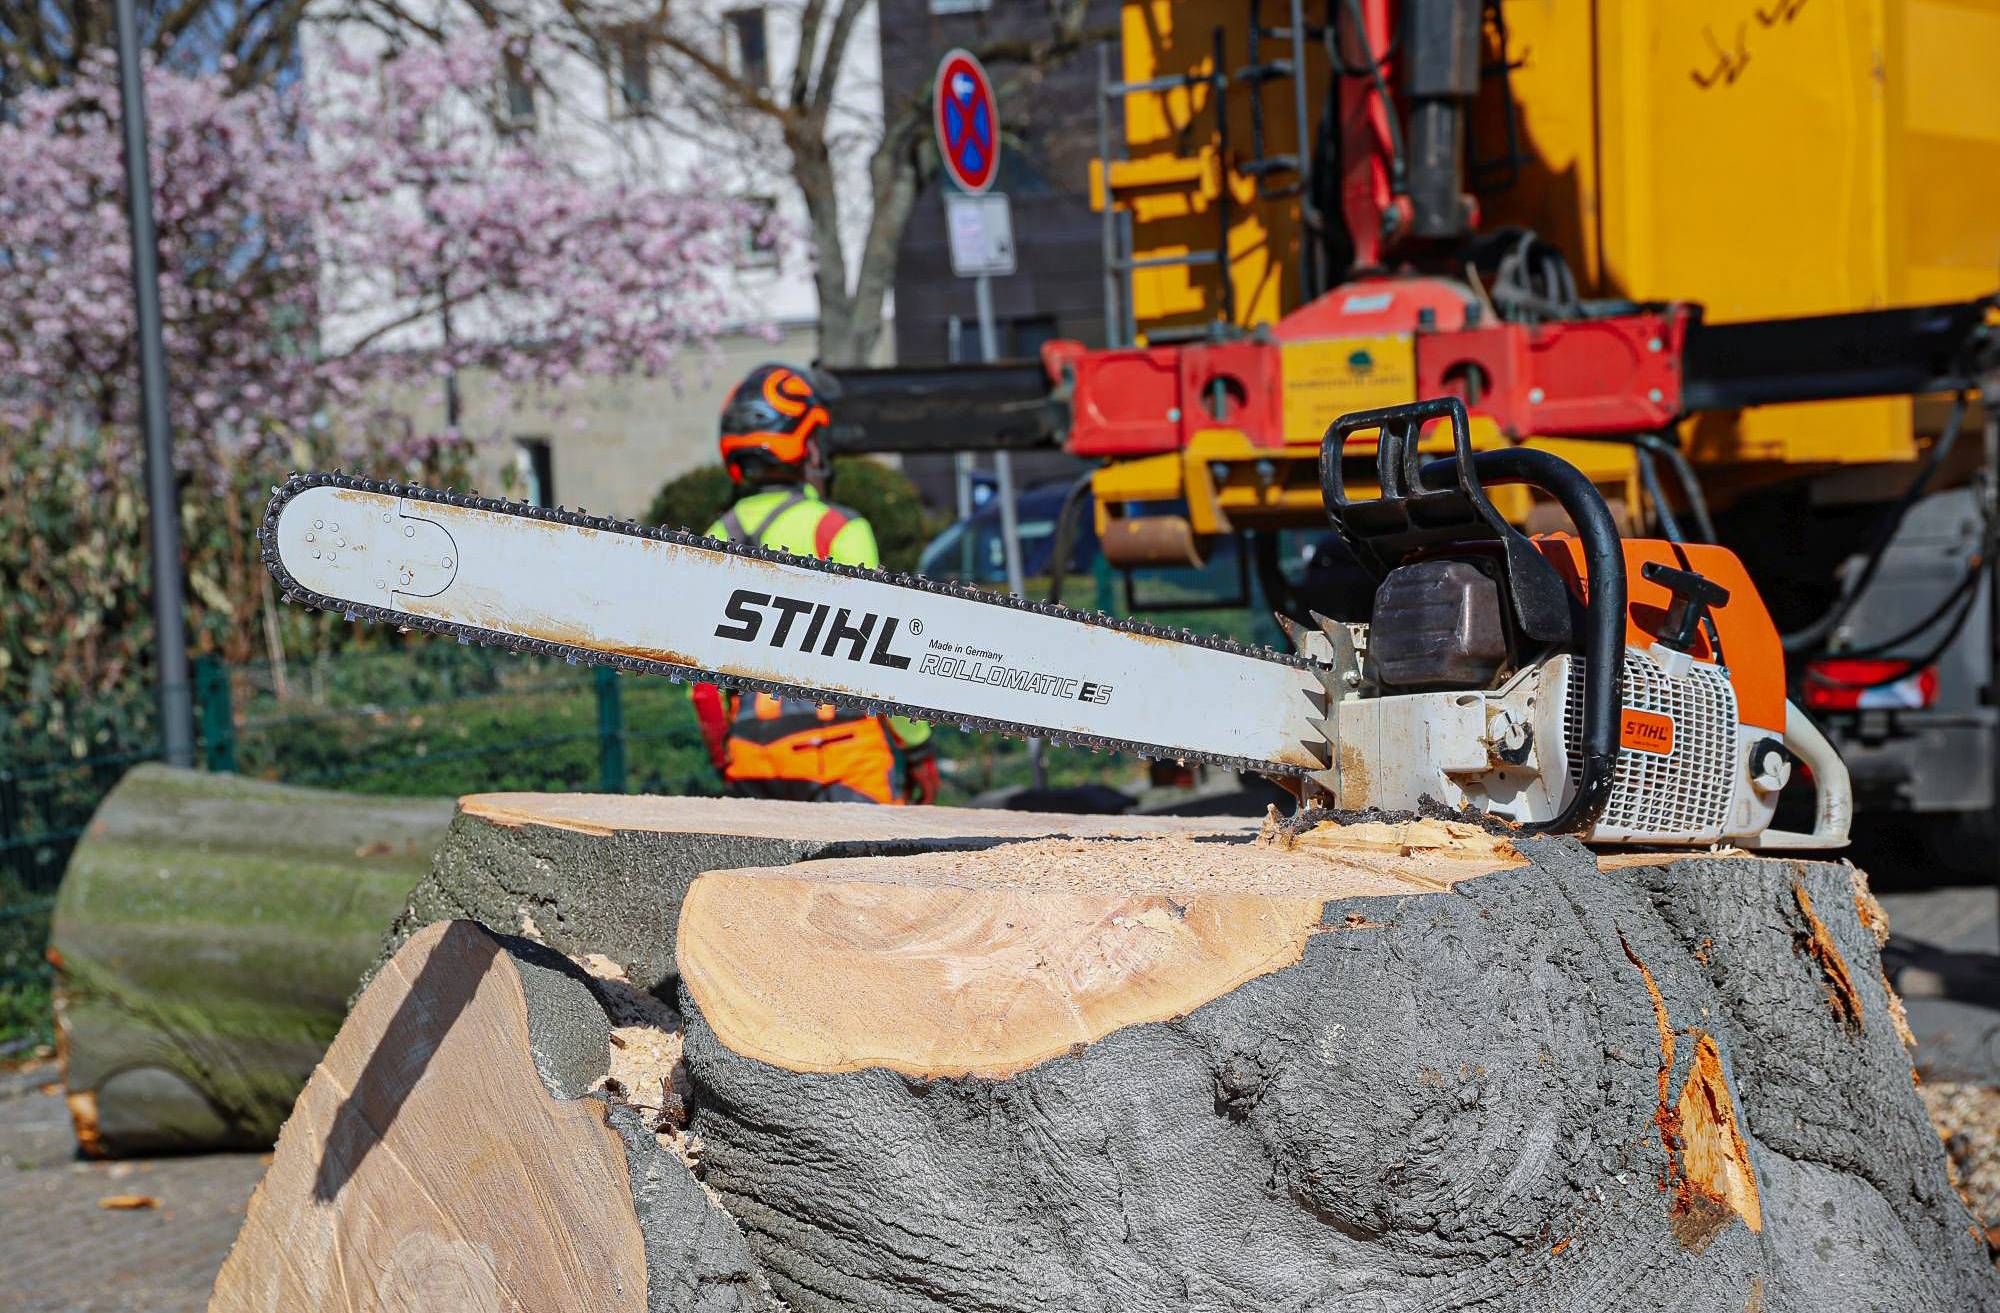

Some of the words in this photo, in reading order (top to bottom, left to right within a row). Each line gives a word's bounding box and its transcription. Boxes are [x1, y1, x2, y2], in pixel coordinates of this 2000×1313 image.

[713, 589, 912, 670] STIHL
[928, 639, 953, 652] Made
[954, 643, 963, 654] in
[965, 645, 1004, 663] Germany
[919, 653, 1078, 699] ROLLOMATIC
[1078, 681, 1114, 705] ES
[1624, 721, 1668, 741] STIHL
